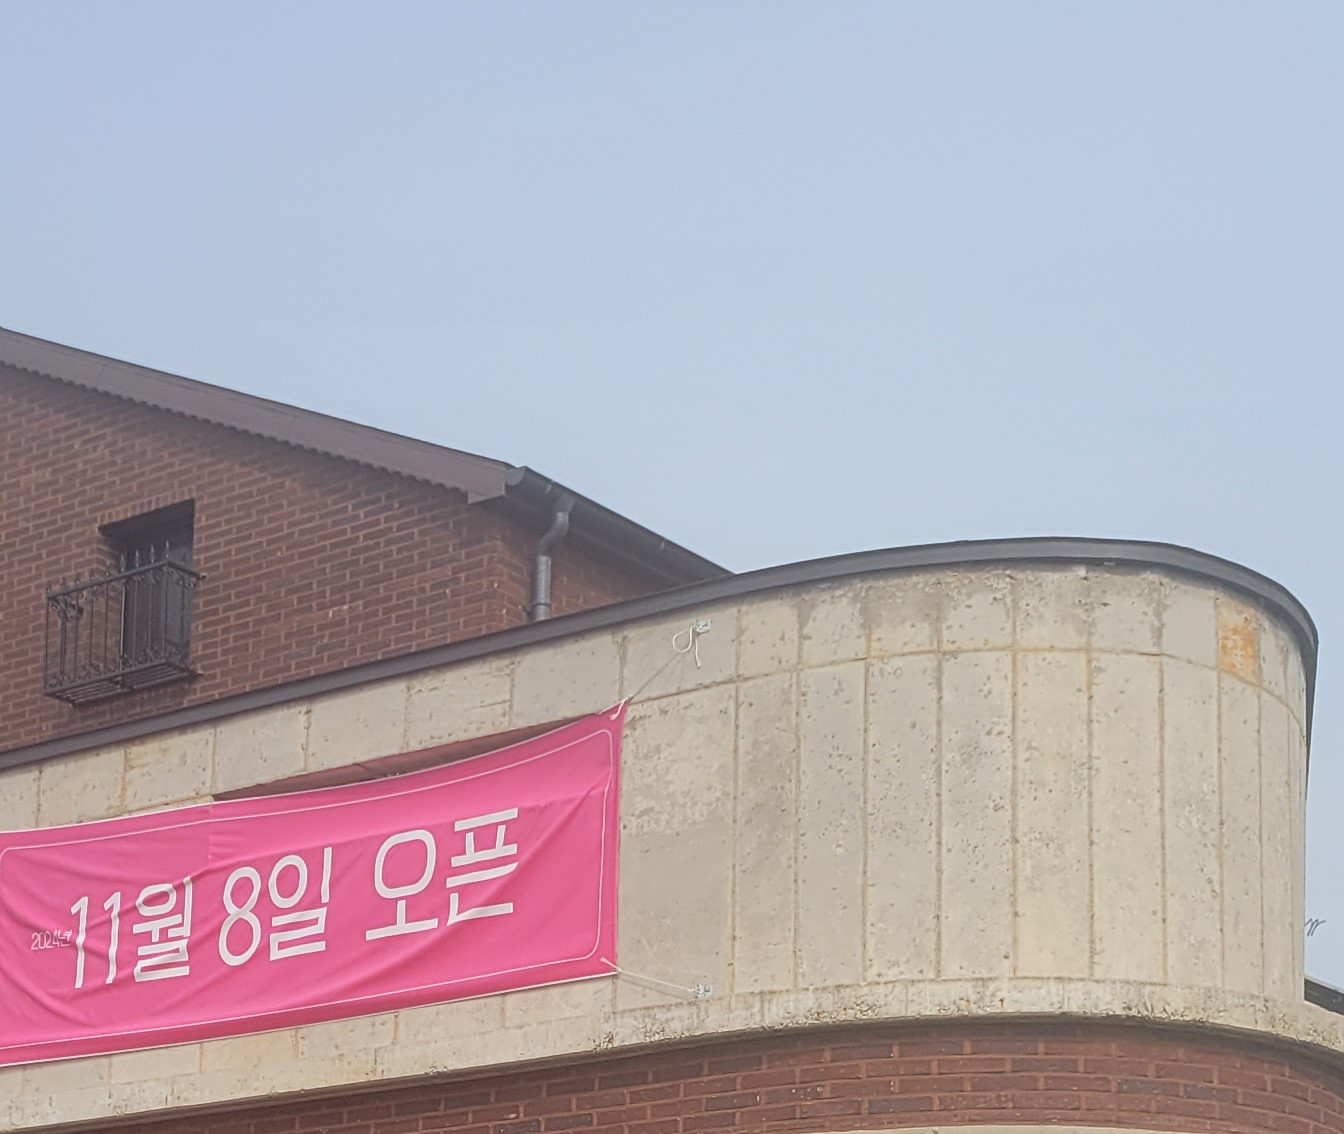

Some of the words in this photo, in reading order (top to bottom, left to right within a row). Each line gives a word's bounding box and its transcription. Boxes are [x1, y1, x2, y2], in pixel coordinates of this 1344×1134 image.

[70, 876, 193, 989] 11월
[218, 847, 333, 967] 8일
[365, 807, 519, 941] 오픈
